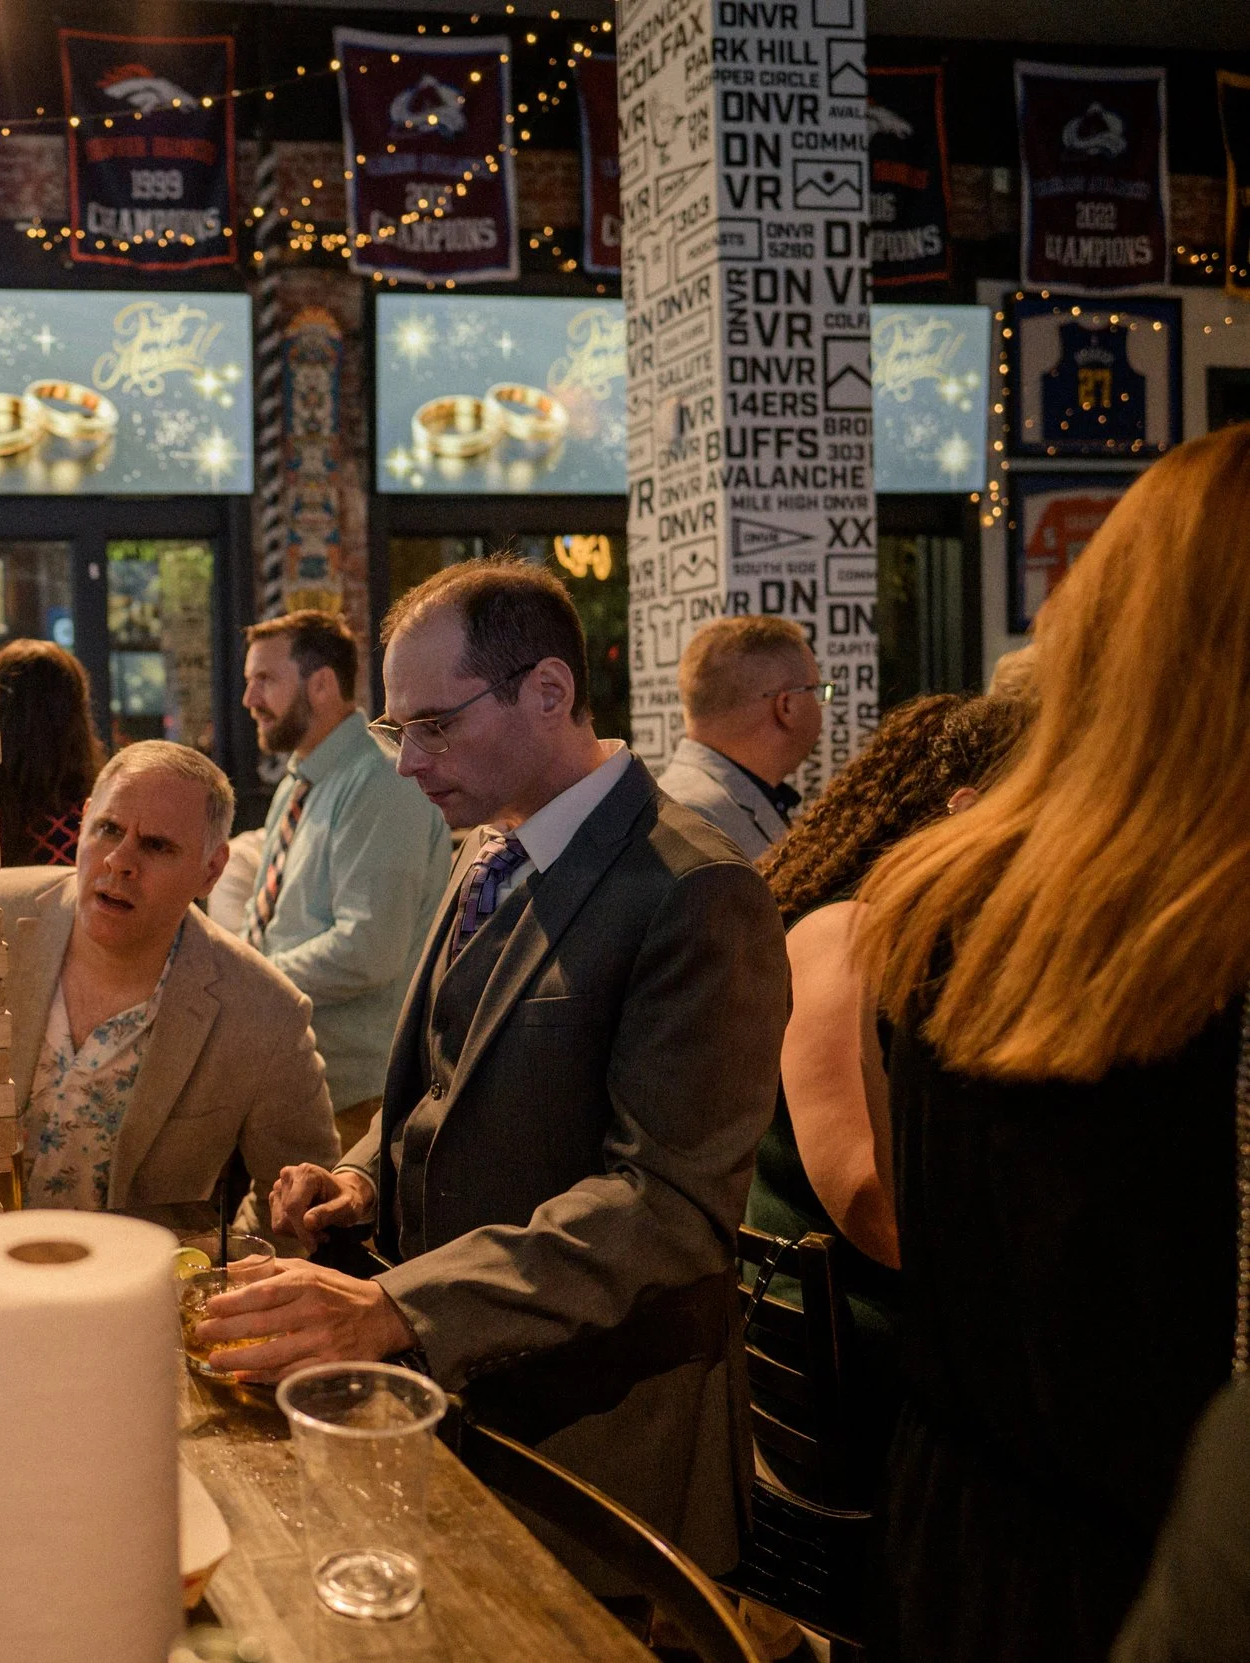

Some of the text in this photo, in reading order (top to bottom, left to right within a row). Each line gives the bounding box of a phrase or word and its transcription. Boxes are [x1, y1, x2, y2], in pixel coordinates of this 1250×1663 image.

[719, 2, 798, 29] DNVR
[619, 4, 705, 101] COLFAX
[757, 38, 820, 66] HILL
[759, 71, 820, 89] CIRCLE
[722, 90, 820, 126] DNVR
[828, 105, 864, 119] AVAL
[656, 274, 711, 325] DNVR
[727, 268, 749, 346] DNVR
[727, 355, 816, 386] DNVR
[727, 392, 819, 417] 14ERS
[658, 500, 717, 543] DNVR
